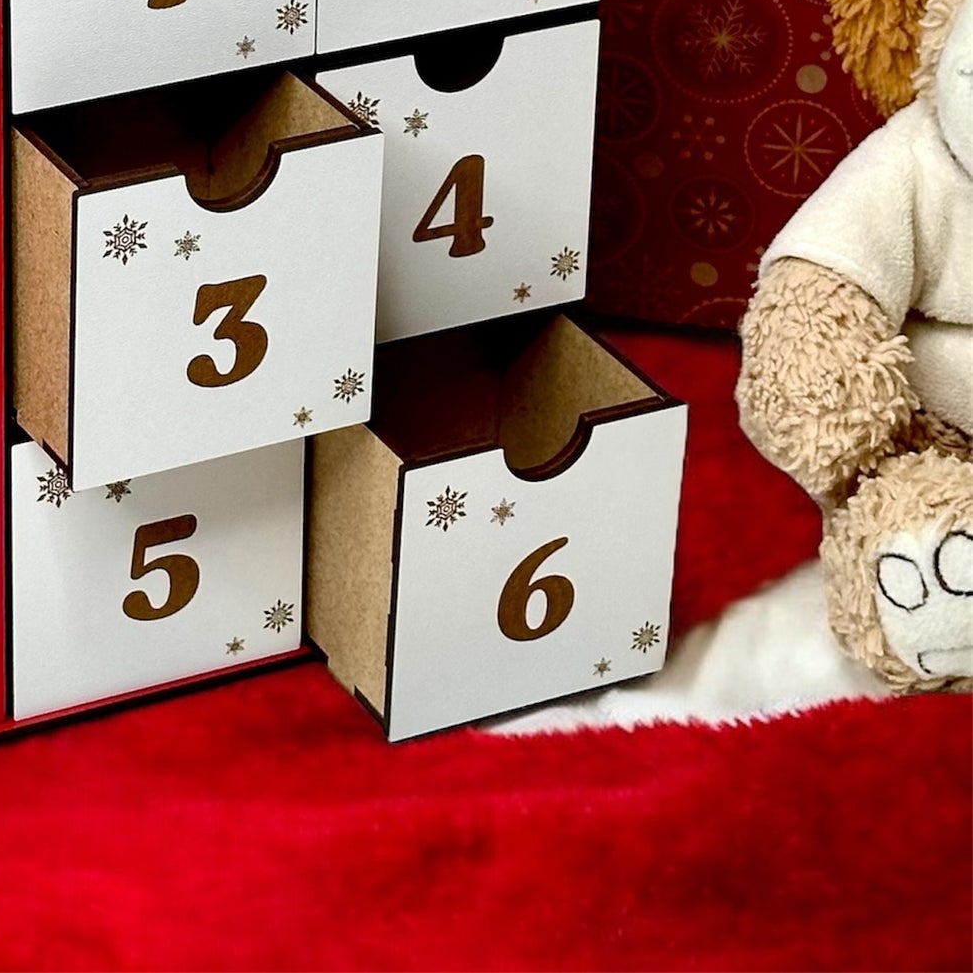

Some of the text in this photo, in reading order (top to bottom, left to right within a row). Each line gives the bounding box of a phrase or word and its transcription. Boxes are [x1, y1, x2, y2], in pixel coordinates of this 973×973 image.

[412, 155, 494, 258] 4
[187, 275, 269, 388] 3
[123, 514, 200, 621] 5
[497, 537, 575, 641] 6
